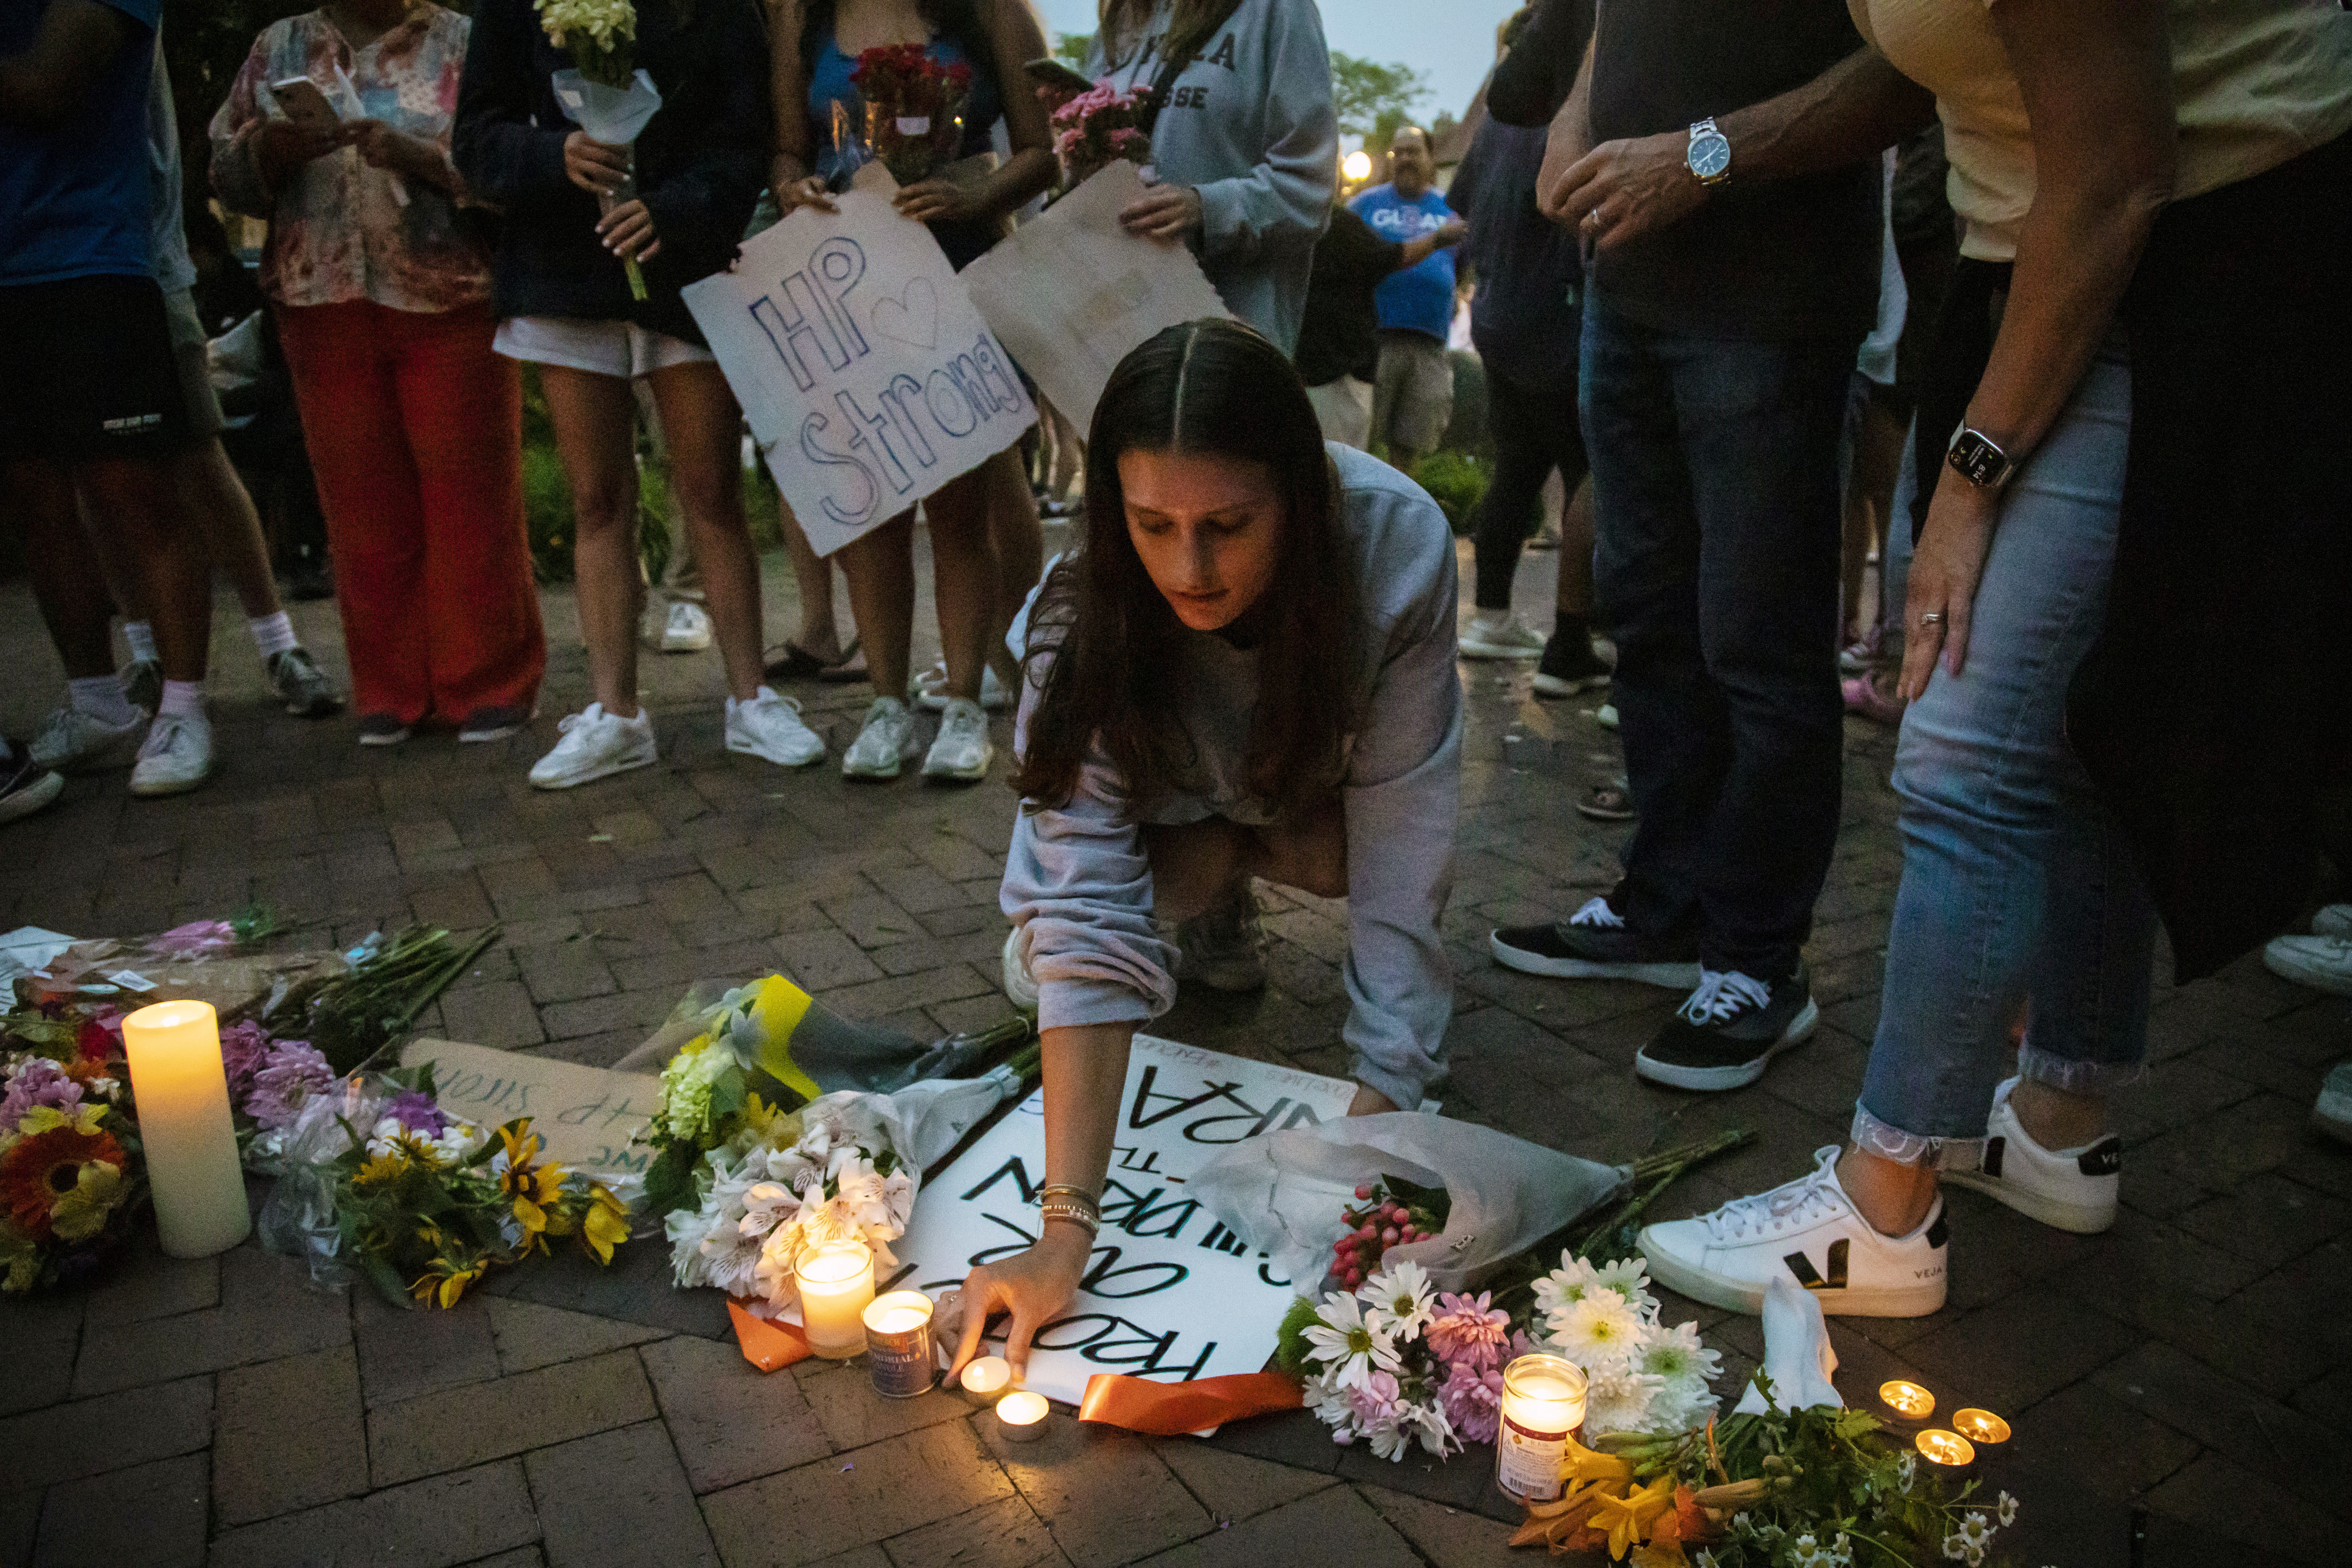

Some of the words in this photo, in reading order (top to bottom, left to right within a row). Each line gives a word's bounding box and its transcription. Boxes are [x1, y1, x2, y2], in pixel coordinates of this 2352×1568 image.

[749, 236, 870, 392] HP
[800, 332, 1024, 526] Strong
[2101, 1152, 2118, 1164] VE
[1914, 1266, 1943, 1279] VEJA
